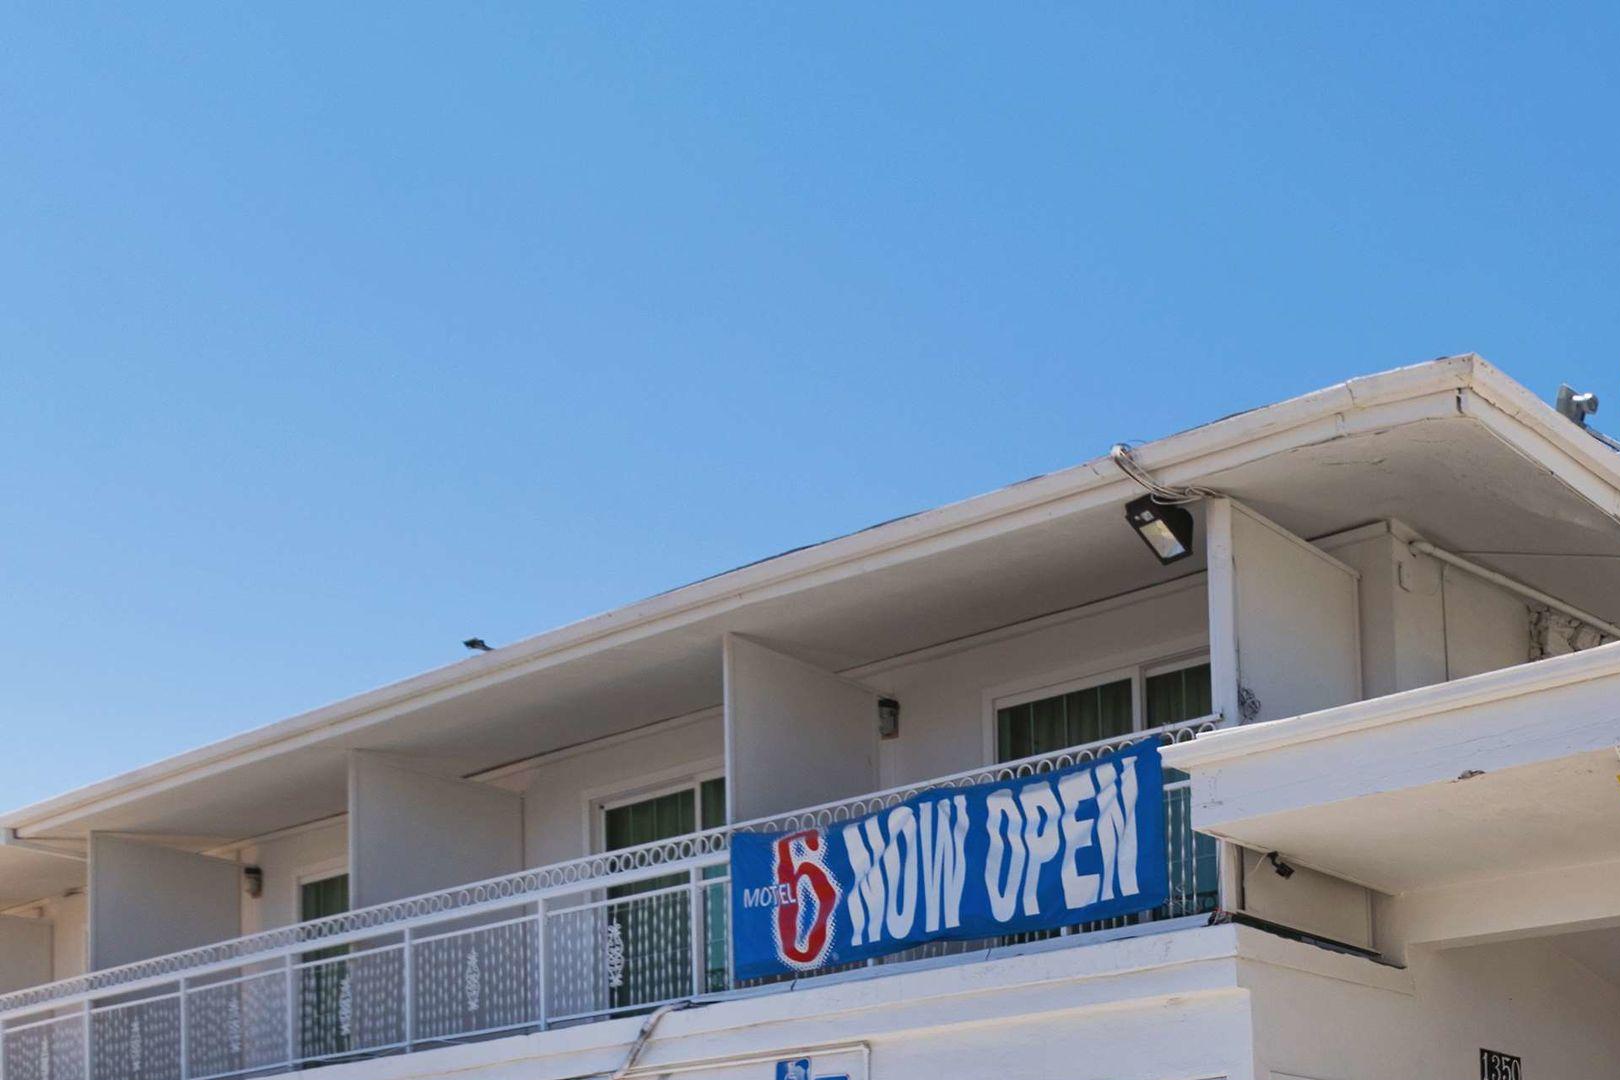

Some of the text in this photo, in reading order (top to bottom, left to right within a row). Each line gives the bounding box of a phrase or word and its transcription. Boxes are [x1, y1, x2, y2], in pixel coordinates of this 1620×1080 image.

[743, 829, 838, 965] MOTEL 6
[842, 756, 1140, 947] NOW OPEN
